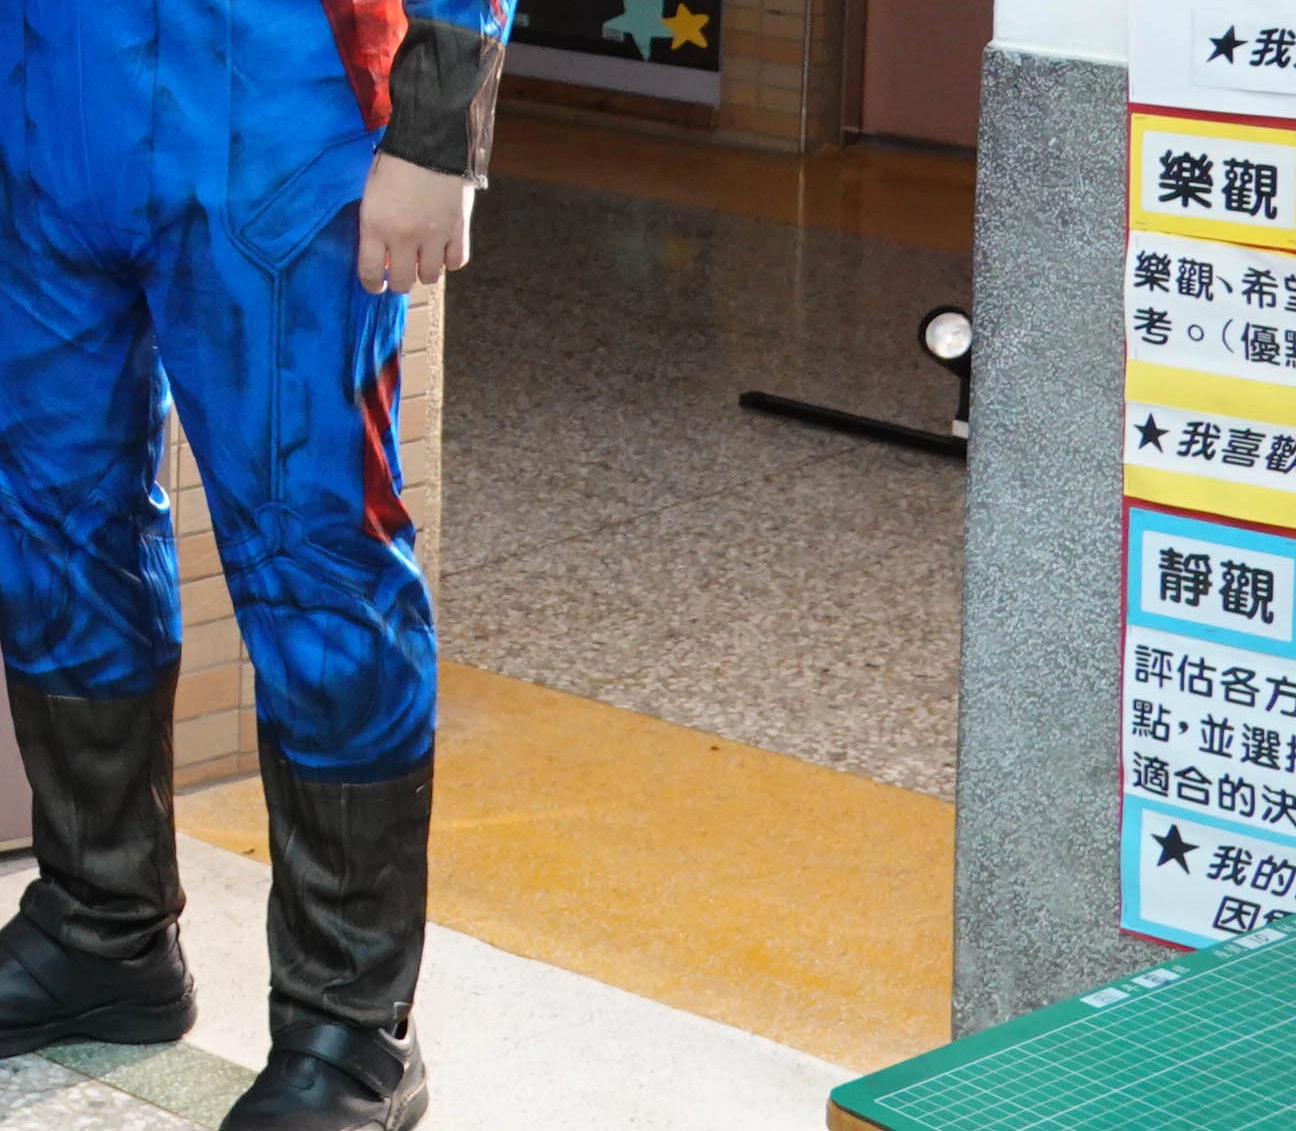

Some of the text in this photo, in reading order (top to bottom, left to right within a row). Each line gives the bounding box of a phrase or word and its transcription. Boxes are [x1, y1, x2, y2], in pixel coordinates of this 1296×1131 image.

[1158, 149, 1278, 220] 樂觀
[1158, 546, 1275, 626] 靜觀
[1135, 644, 1296, 718] 評估各方
[1132, 698, 1296, 774] 點，並選
[1132, 751, 1296, 827] 適合的決
[1206, 845, 1296, 897] 我的
